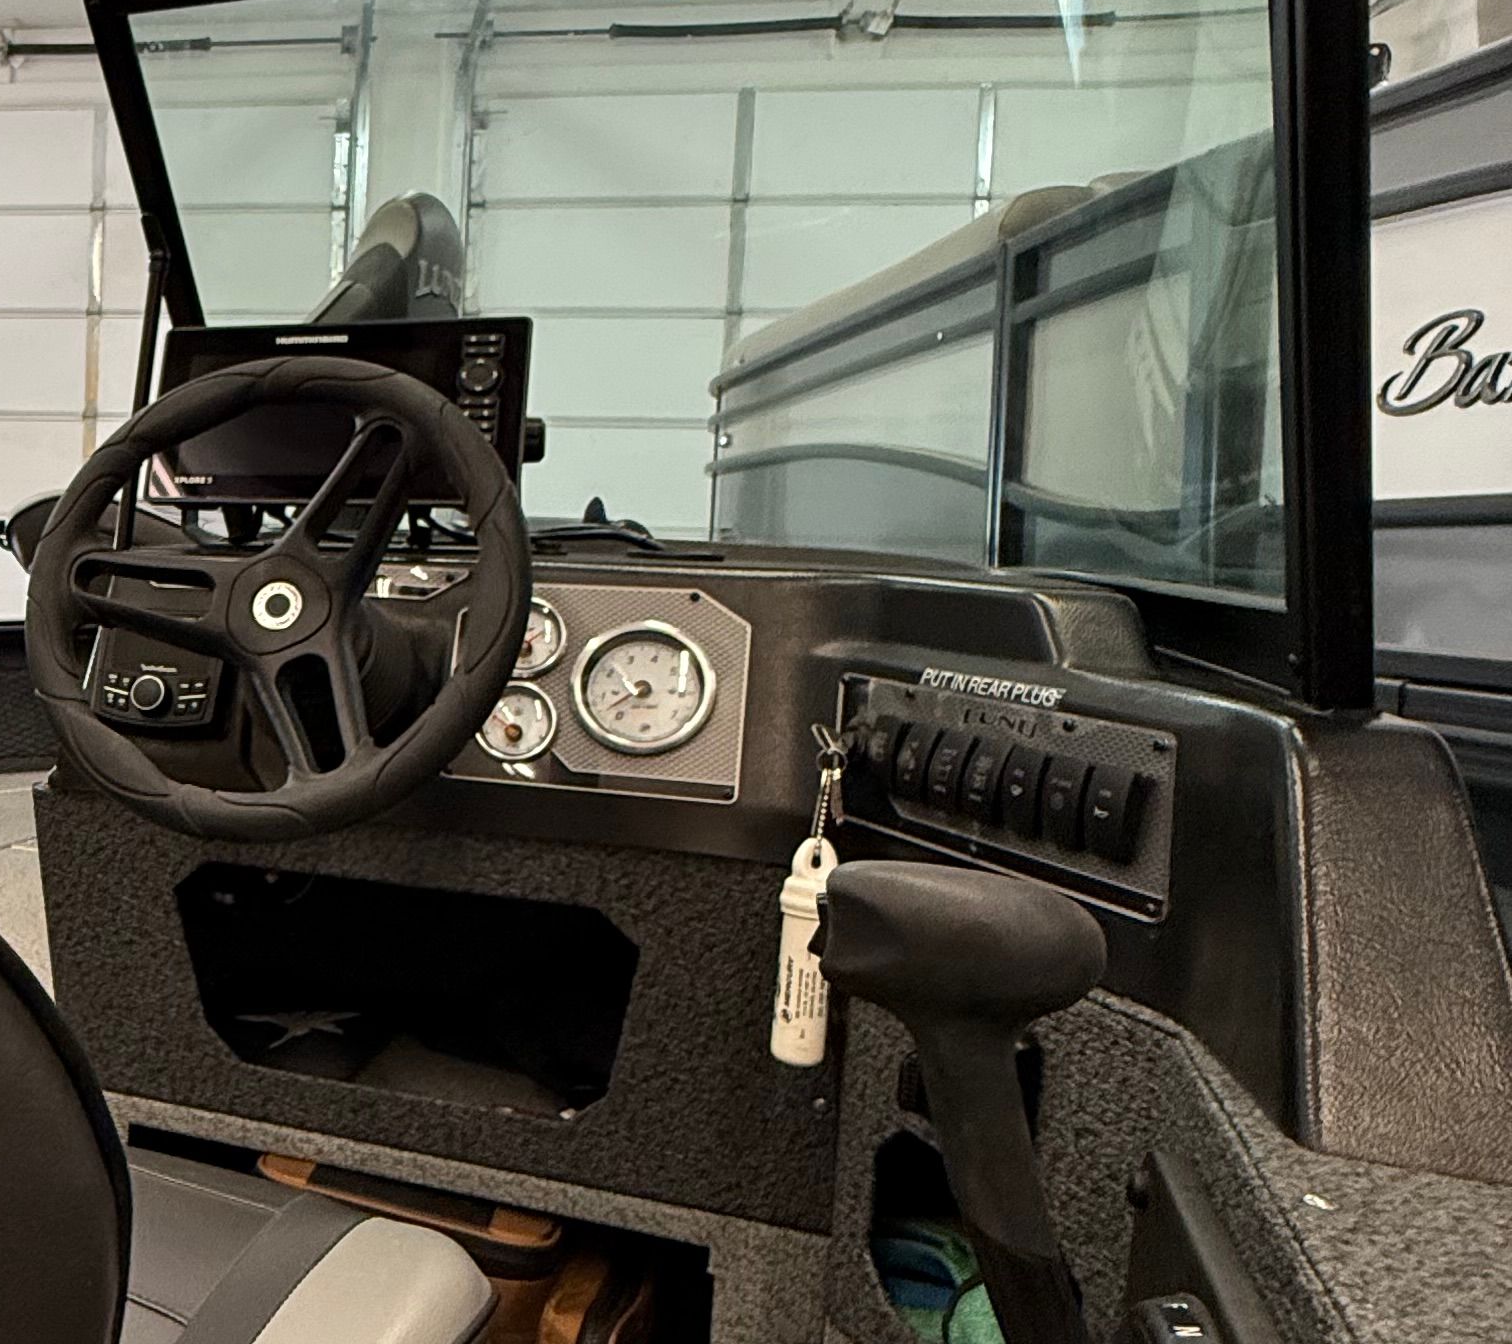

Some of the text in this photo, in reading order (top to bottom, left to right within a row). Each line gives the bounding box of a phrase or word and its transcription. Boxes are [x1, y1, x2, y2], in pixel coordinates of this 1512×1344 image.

[1376, 308, 1512, 417] Ba
[920, 667, 953, 689] PUT
[950, 672, 968, 693] IN
[966, 675, 1011, 699] REAR
